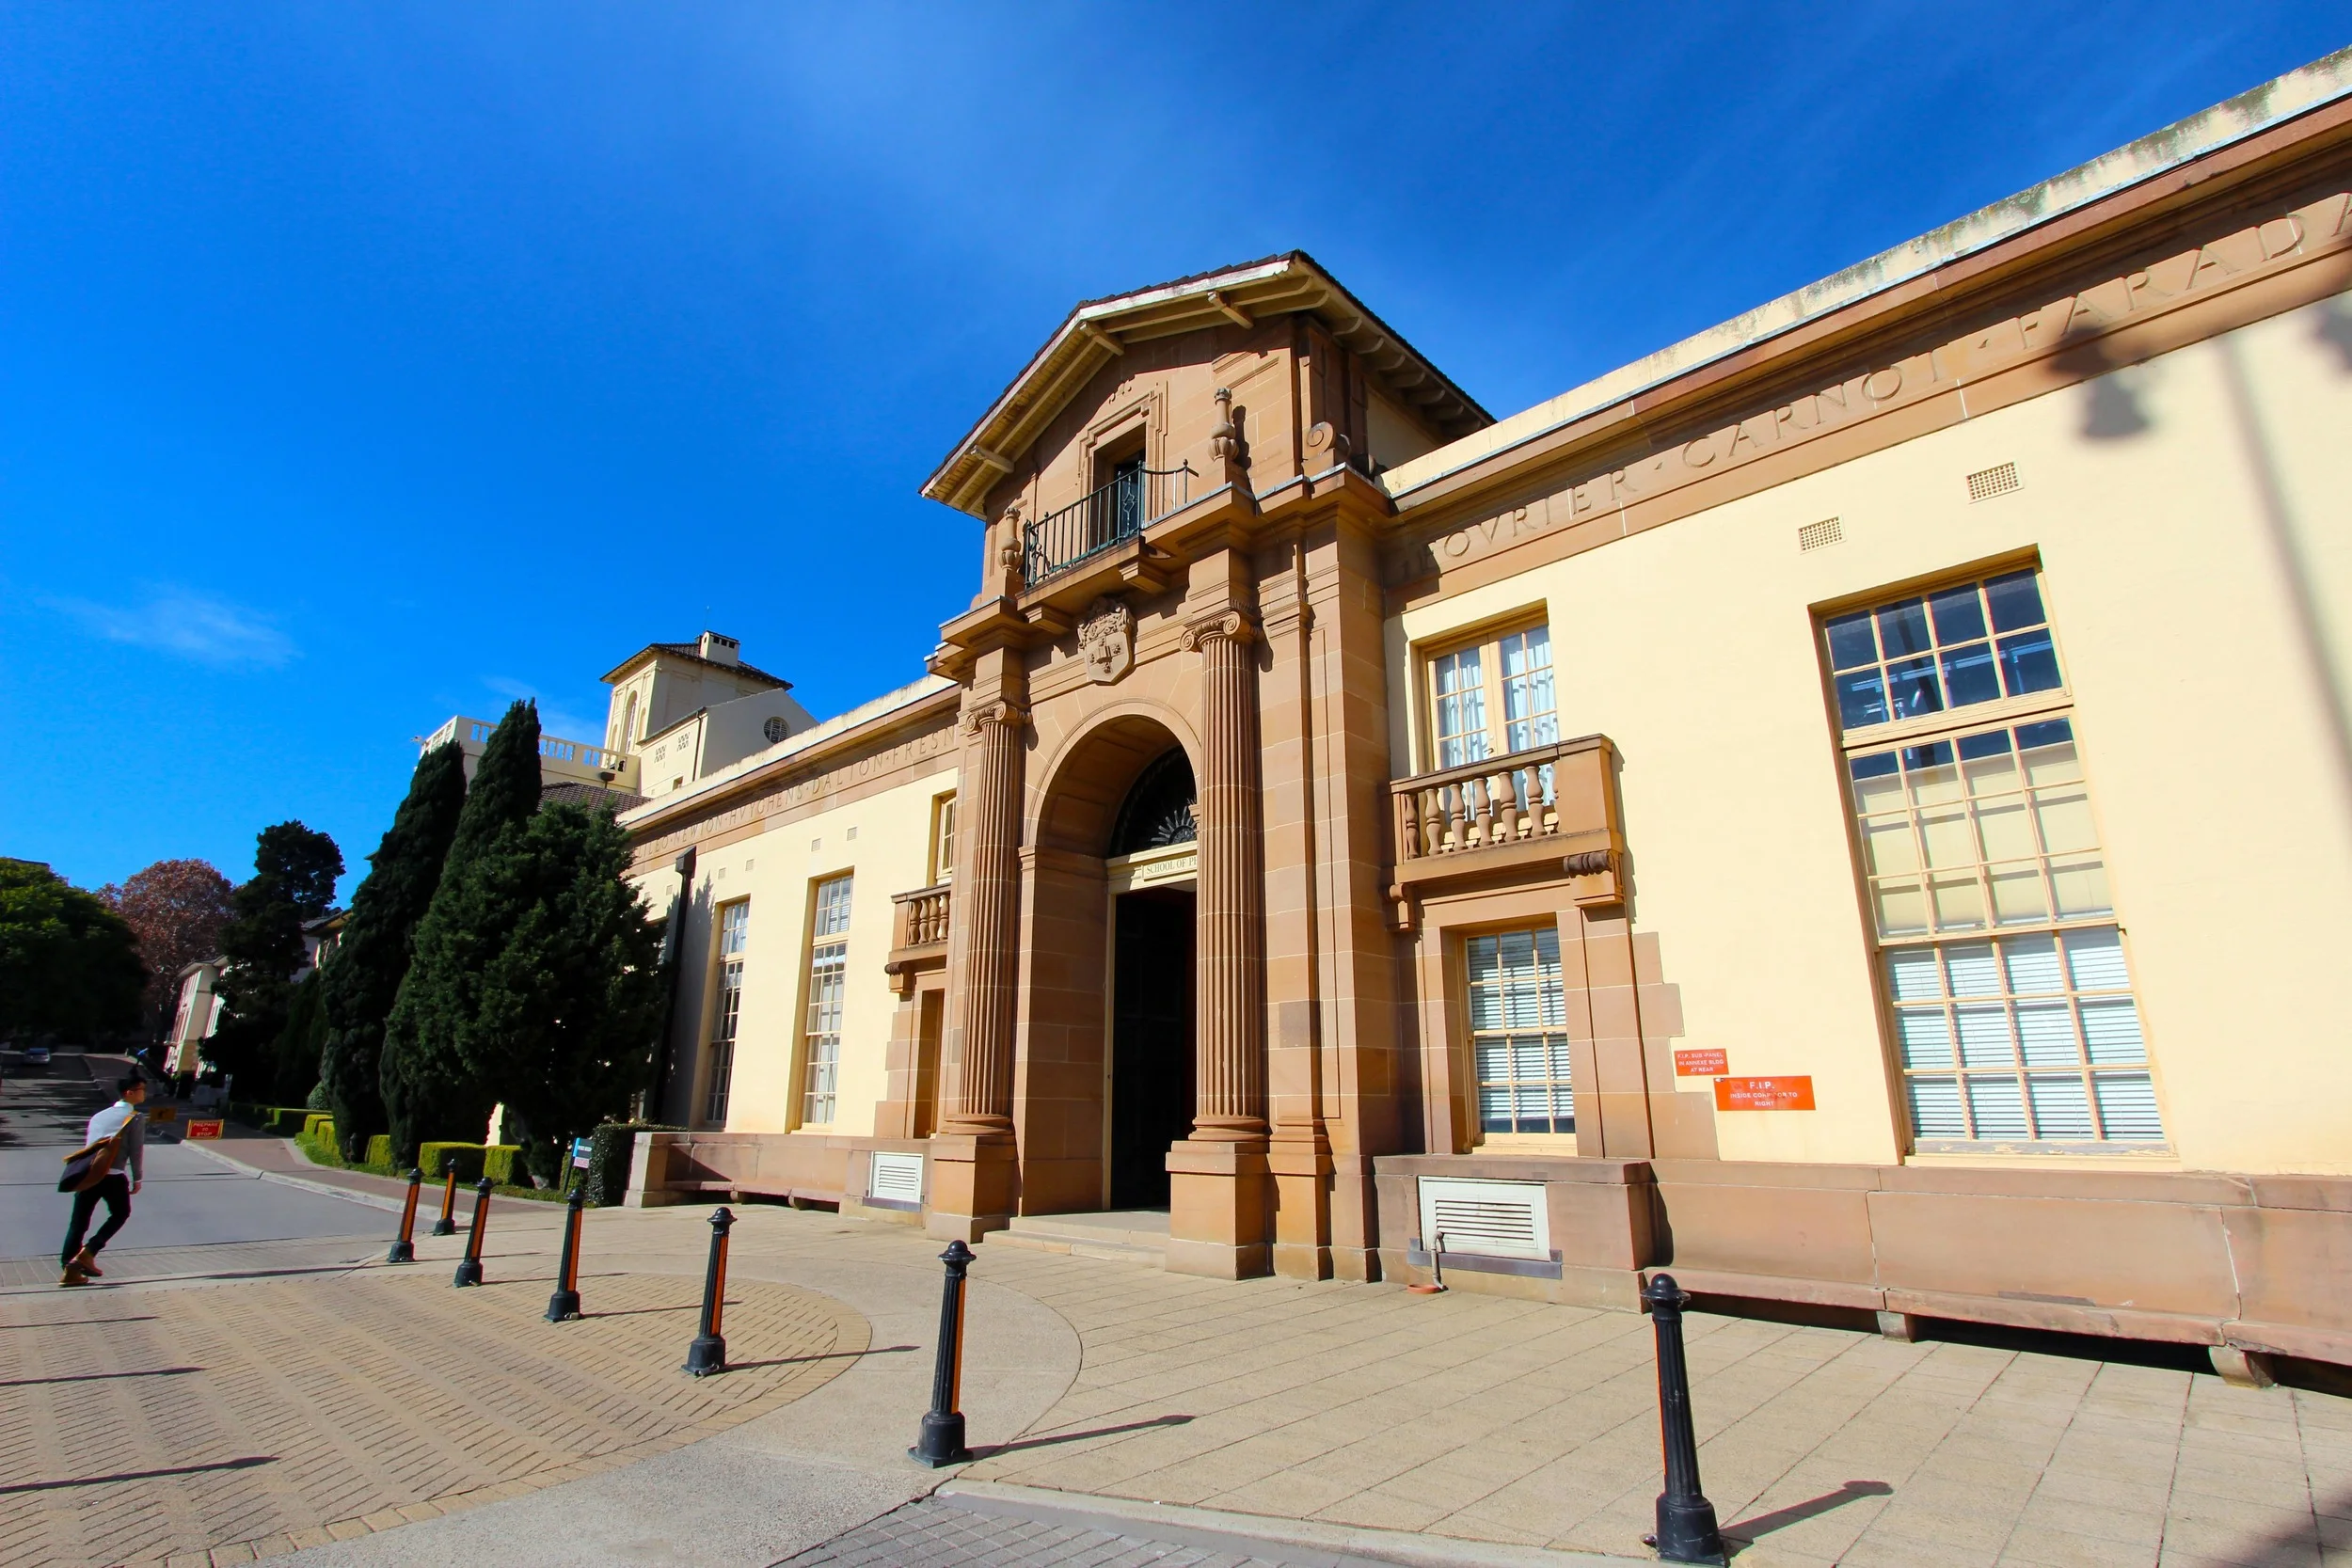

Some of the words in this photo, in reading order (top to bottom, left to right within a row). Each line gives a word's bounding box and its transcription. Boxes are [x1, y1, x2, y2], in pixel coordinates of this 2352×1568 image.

[674, 816, 723, 845] NEWTON
[812, 752, 882, 795] DALTON
[1146, 861, 1175, 874] SCHOOL
[1176, 859, 1186, 868] OF
